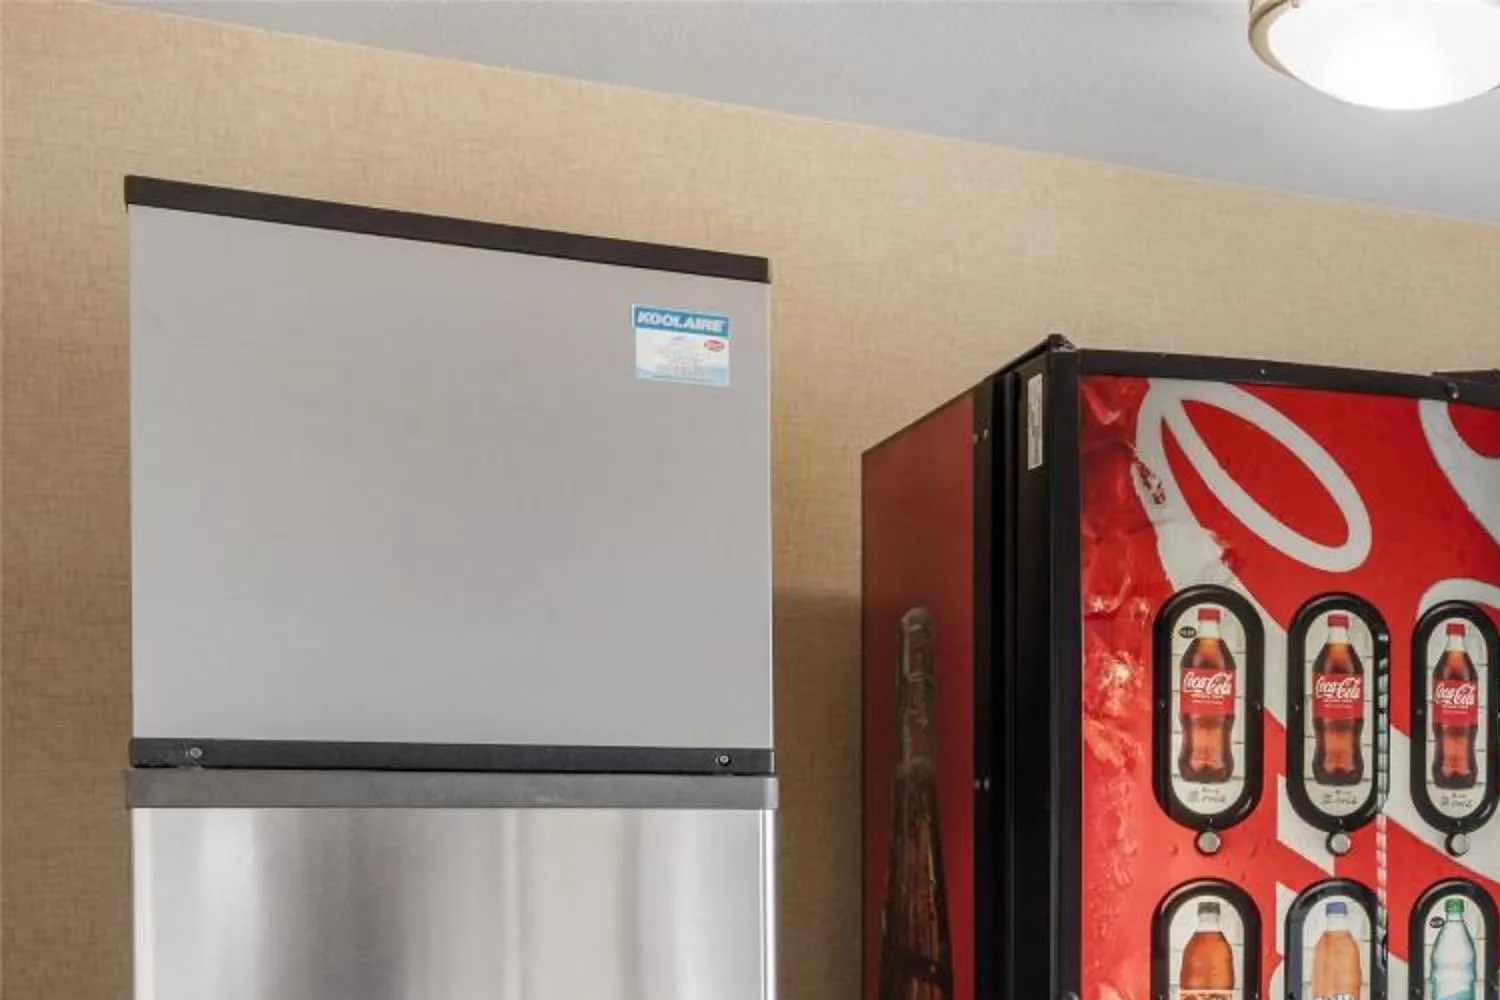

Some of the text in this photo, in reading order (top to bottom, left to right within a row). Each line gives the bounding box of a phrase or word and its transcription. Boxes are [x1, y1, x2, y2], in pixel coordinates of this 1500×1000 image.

[637, 311, 723, 332] KOOLAIRE
[1184, 671, 1233, 695] Coca-Cola
[1316, 675, 1361, 699] Coca-Cola
[1435, 681, 1476, 705] Coca-Cola
